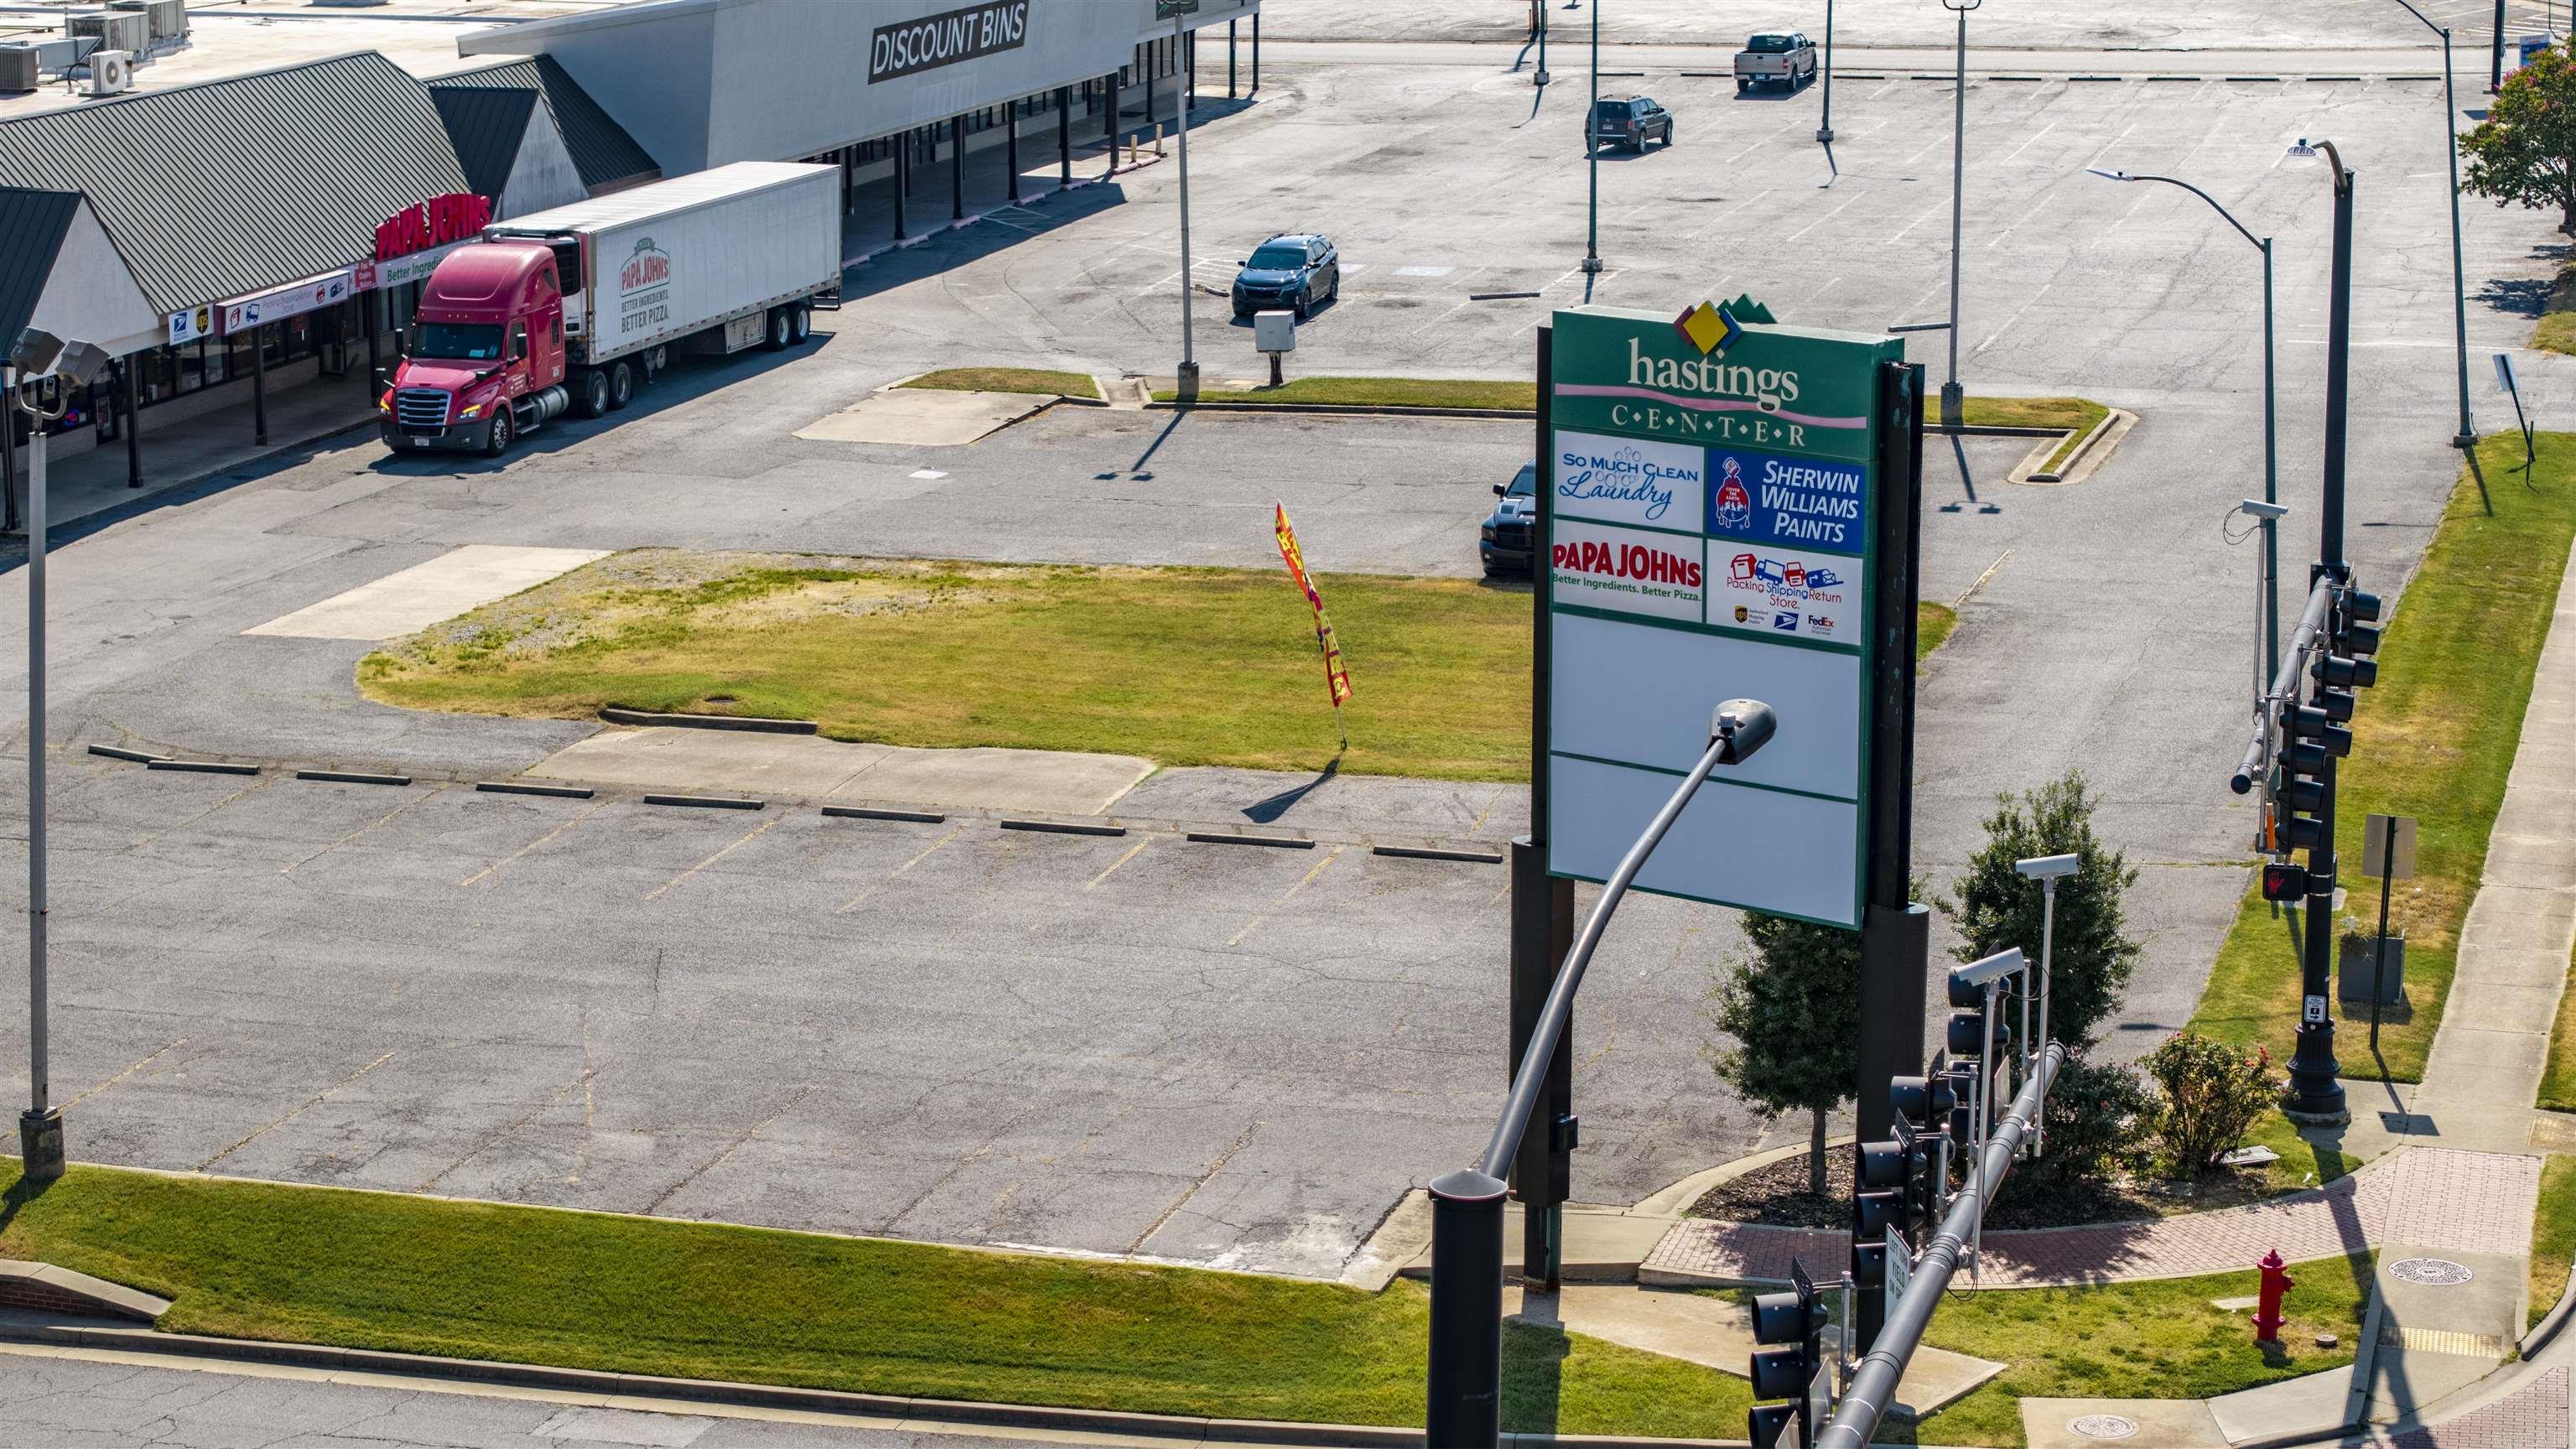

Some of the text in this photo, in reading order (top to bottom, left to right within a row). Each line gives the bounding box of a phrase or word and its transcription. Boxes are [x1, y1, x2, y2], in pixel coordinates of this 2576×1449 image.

[873, 2, 1026, 75] DISCOUNT BINS
[376, 192, 491, 261] PAPA JOHNS
[387, 254, 442, 283] Better Ingredi
[621, 260, 642, 292] PAPA
[621, 298, 638, 314] BETTER
[197, 314, 209, 331] ups
[621, 312, 647, 334] BETTER
[1628, 336, 1800, 413] hastings
[1763, 460, 1859, 494] SHERWIN
[1558, 470, 1673, 521] Laundry
[1774, 512, 1846, 543] PAINTS
[1552, 542, 1701, 587] PAPA JOHNS
[1553, 573, 1701, 602] Better Ingredients. Better Pizza.
[1727, 576, 1842, 604] Packing Shipping Return
[1769, 594, 1800, 610] Store.
[1735, 611, 1747, 621] ups
[1808, 615, 1835, 628] FedEx
[1889, 1237, 1898, 1256] LEFT
[1889, 1278, 1895, 1296] ON
[1892, 1259, 1905, 1288] YIELD
